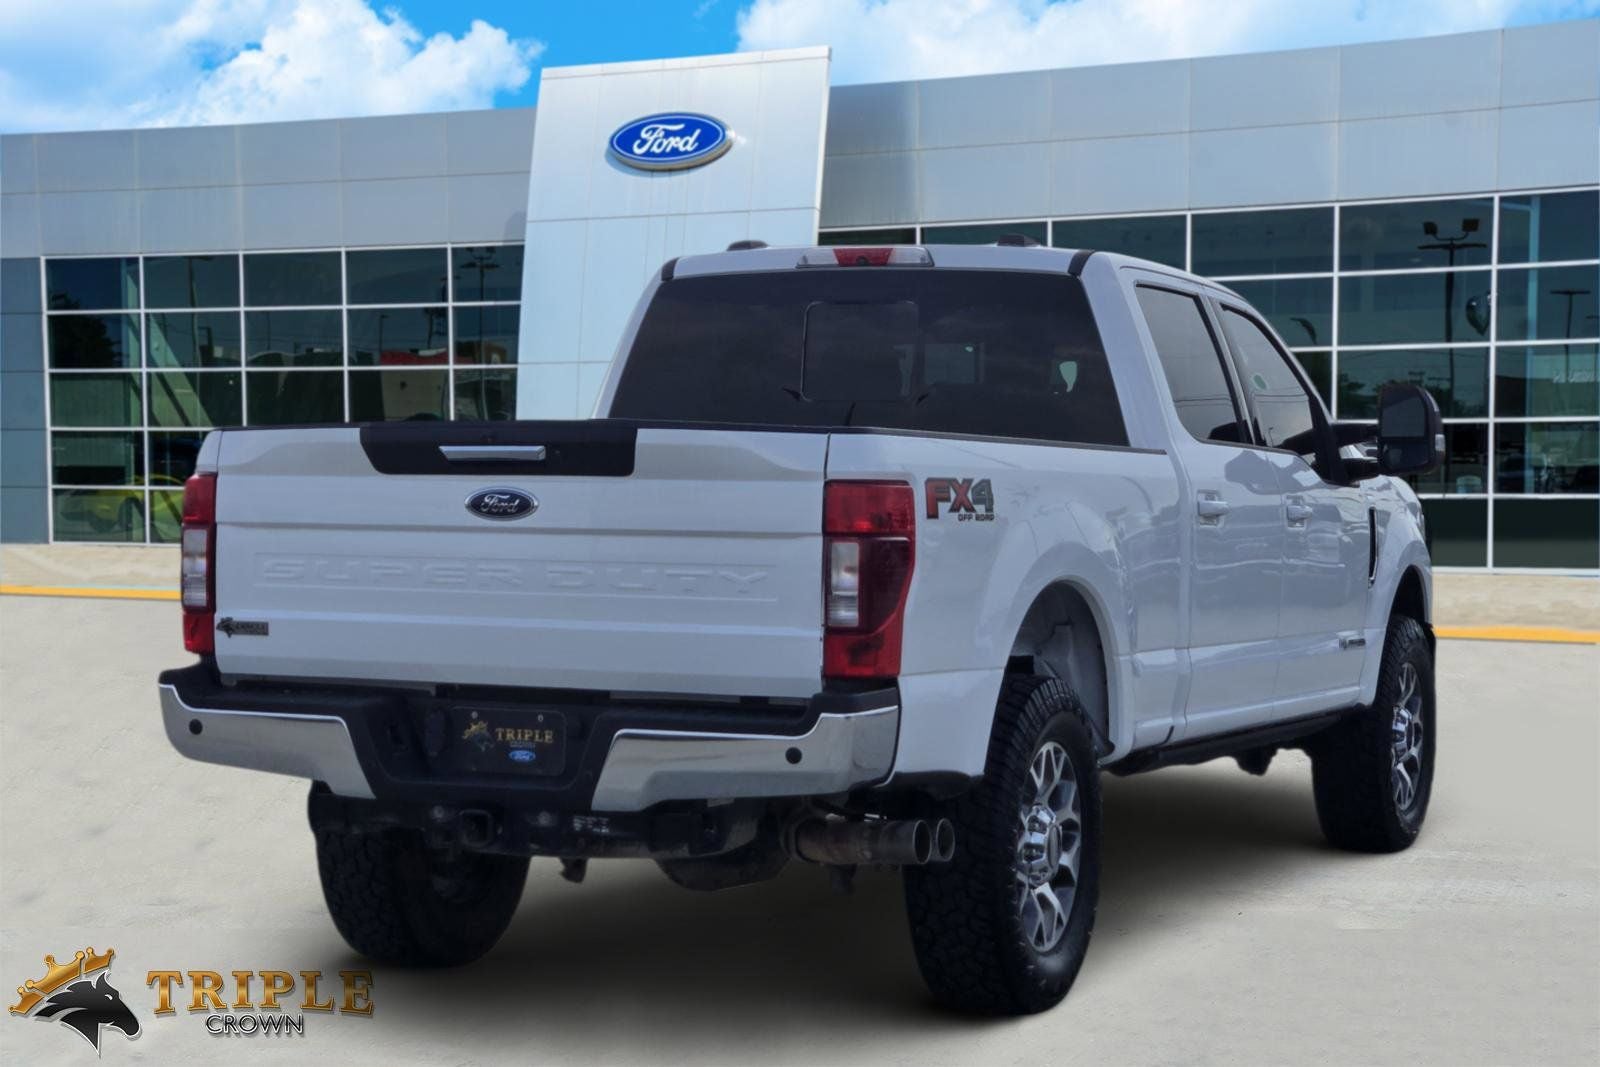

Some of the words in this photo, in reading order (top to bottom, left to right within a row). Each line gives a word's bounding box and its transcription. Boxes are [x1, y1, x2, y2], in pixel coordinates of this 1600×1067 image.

[632, 123, 702, 155] Ford
[480, 493, 520, 513] Ford
[924, 477, 995, 520] FX4
[262, 558, 525, 587] SUPER
[545, 565, 769, 594] DUTY
[495, 728, 554, 744] TRIPLE
